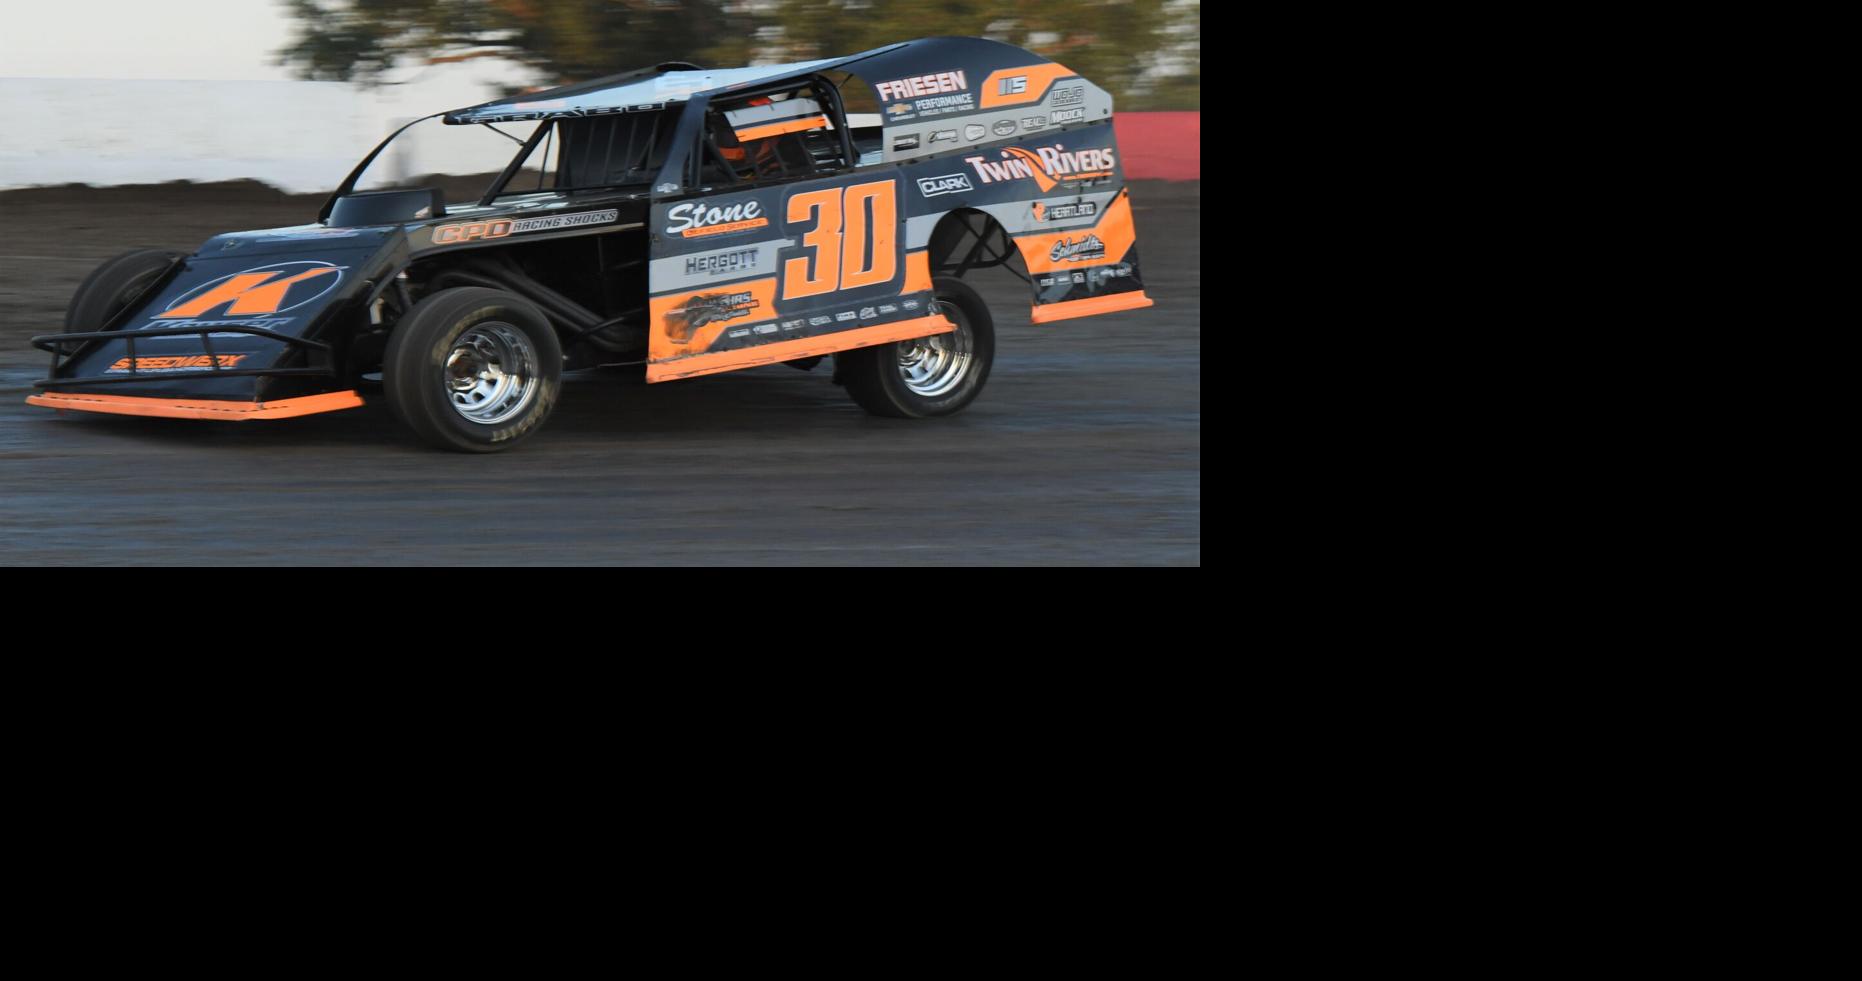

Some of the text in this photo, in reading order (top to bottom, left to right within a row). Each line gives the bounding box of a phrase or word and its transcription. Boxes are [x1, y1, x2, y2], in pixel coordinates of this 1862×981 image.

[875, 70, 967, 101] FRIESEN
[915, 93, 975, 110] PERFORMANCE
[920, 176, 968, 194] CLARK
[432, 211, 618, 244] CPD RACING SHOCKS
[665, 201, 762, 233] Stone
[783, 179, 897, 300] 30
[684, 247, 759, 275] HERGOTT
[150, 266, 349, 319] K
